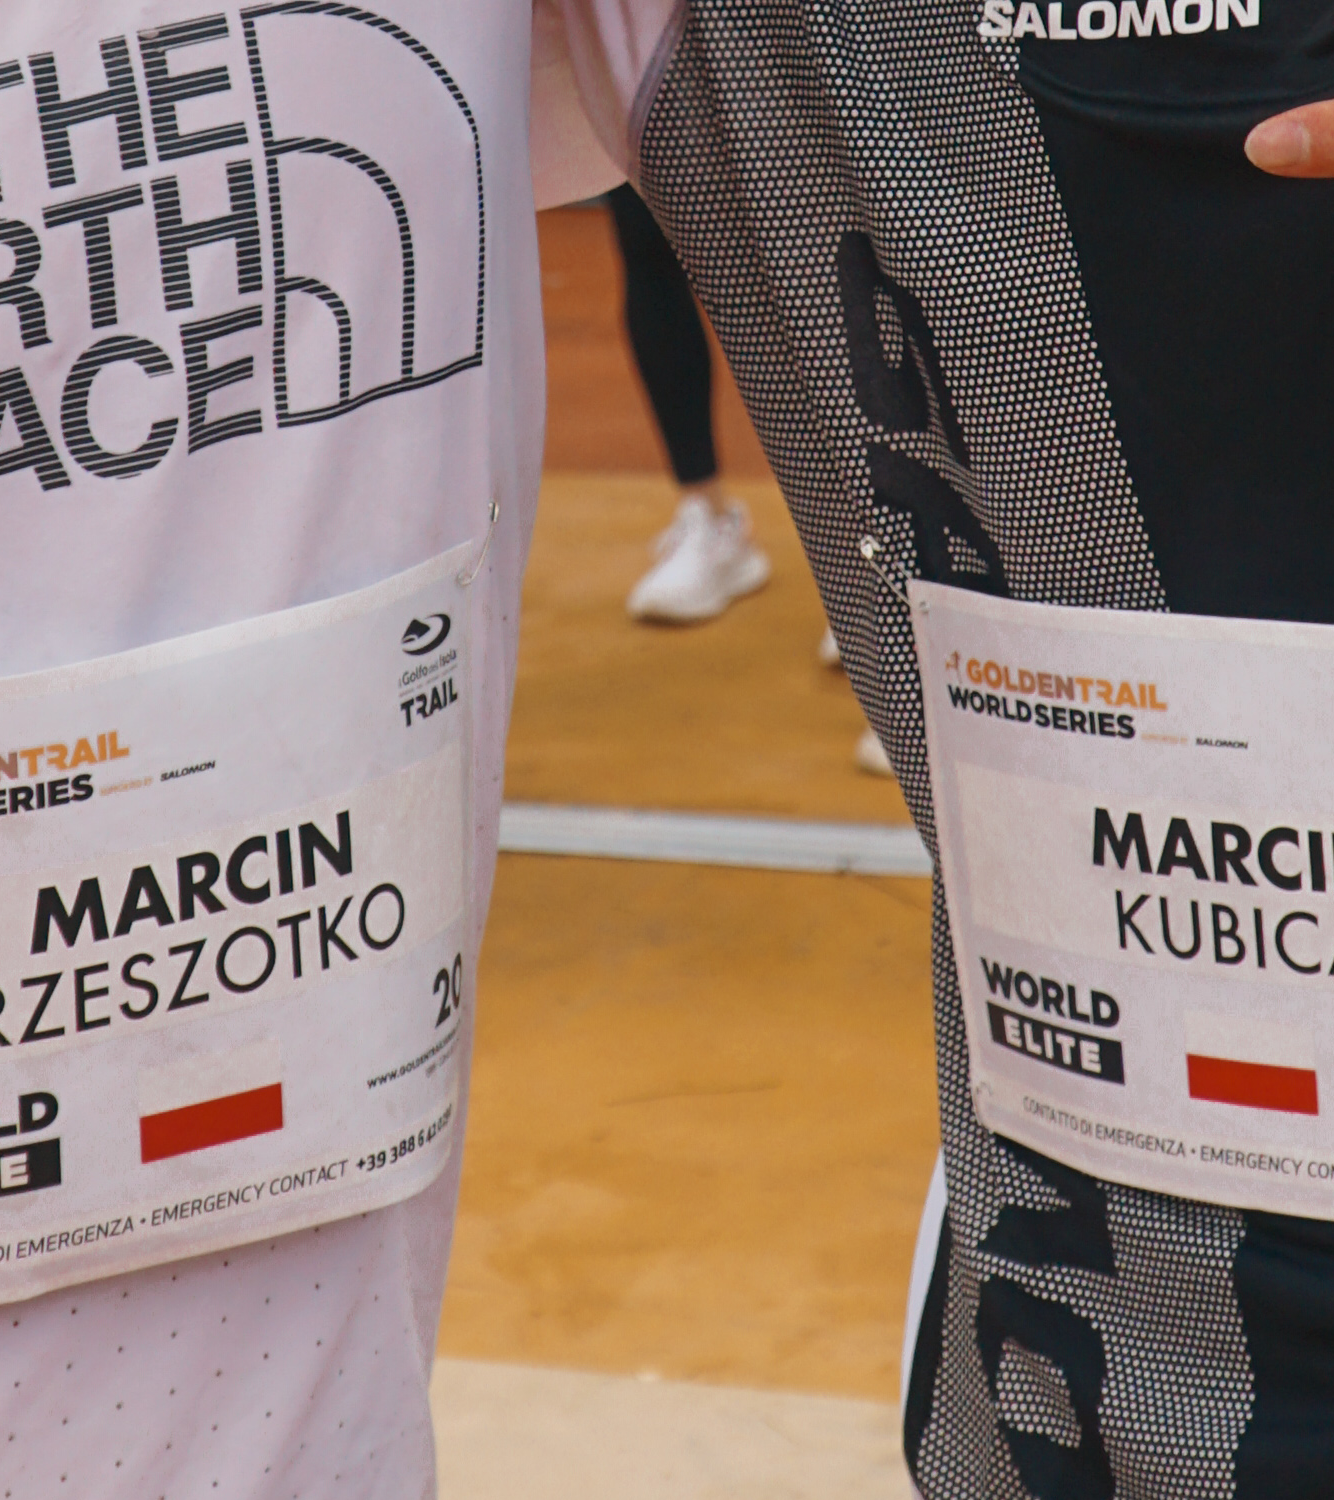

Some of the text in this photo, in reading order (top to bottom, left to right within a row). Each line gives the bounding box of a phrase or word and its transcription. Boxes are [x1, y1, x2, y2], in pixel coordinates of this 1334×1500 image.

[400, 677, 458, 728] TRAIL
[159, 759, 217, 783] SALOMON
[1195, 737, 1249, 750] SALOMON
[30, 810, 353, 955] MARCIN
[980, 955, 1120, 1028] WORLD
[1003, 1014, 1102, 1074] ELITE
[1023, 1096, 1079, 1131] CONTATTO
[1080, 1121, 1093, 1135] DI
[1095, 1123, 1187, 1157] EMERGENZA
[1200, 1145, 1303, 1176] EMERGENCY
[16, 1216, 134, 1260] EMERGENZA
[151, 1182, 266, 1227] EMERGENCY
[269, 1159, 349, 1196] CONTACT
[356, 1150, 387, 1172] +39
[389, 1134, 416, 1164] 388
